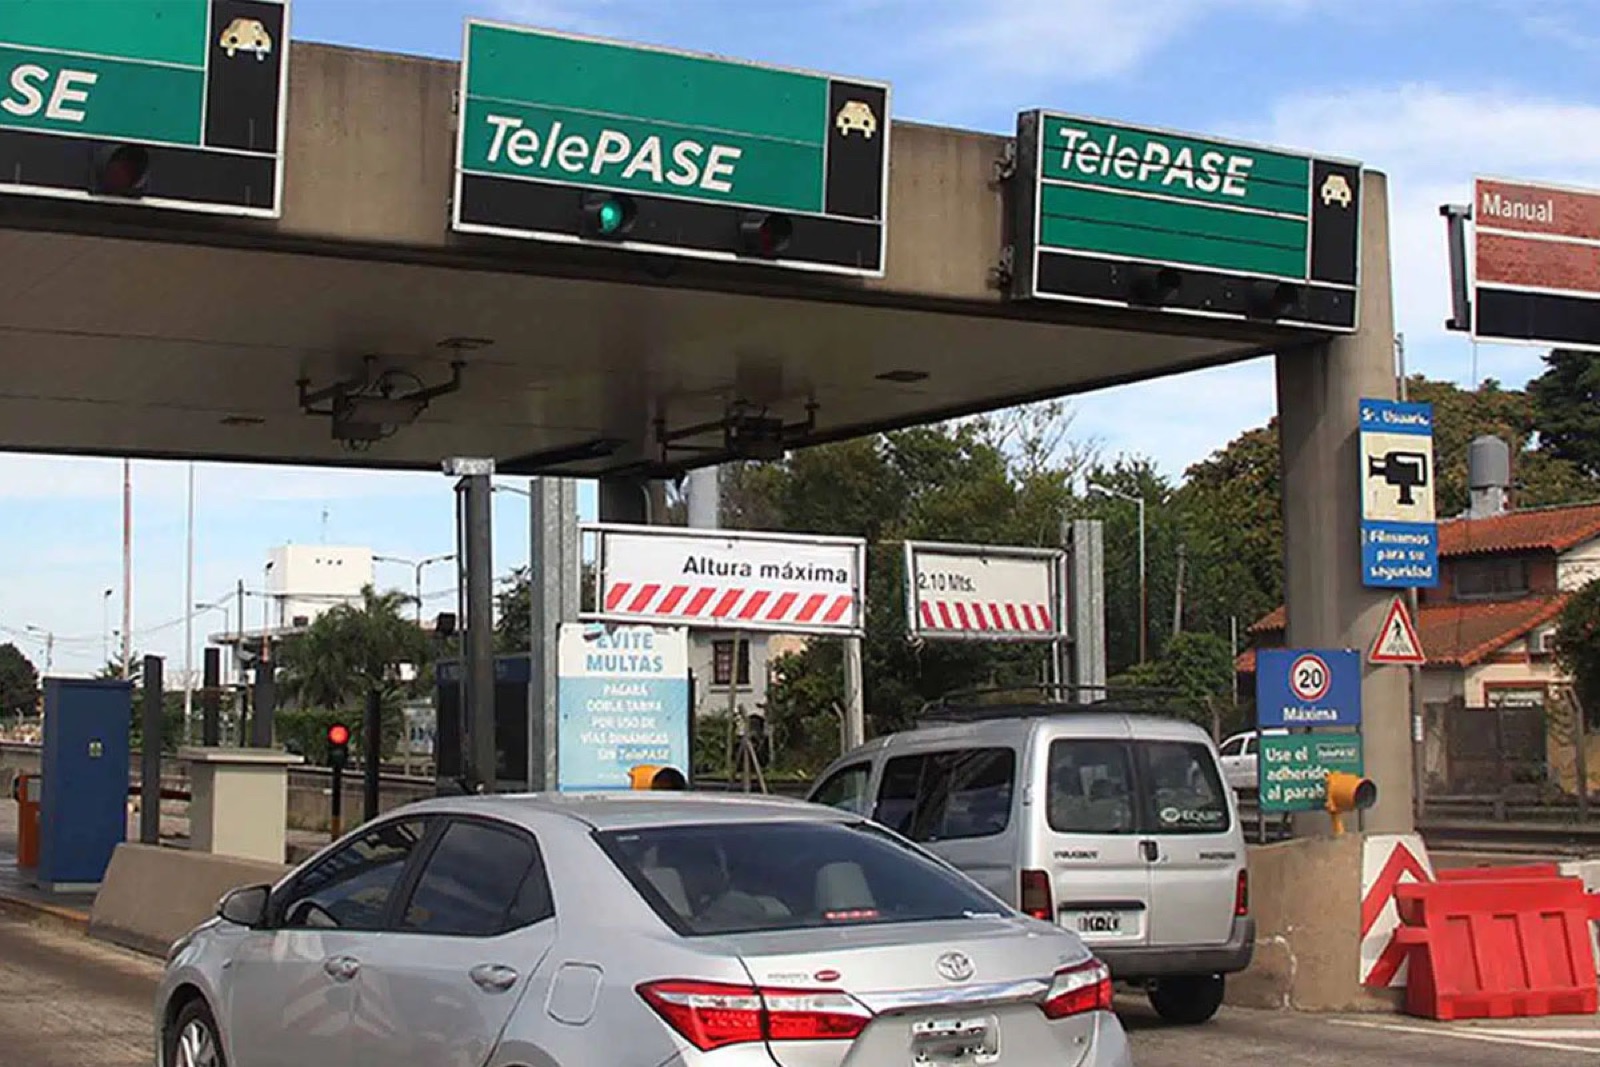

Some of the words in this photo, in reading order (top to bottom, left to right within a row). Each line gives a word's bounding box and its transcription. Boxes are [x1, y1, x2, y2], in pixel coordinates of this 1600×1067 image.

[486, 114, 743, 193] TelePASE
[1059, 127, 1254, 197] TelePASE
[1482, 192, 1554, 224] Manual
[1376, 549, 1406, 562] para
[1409, 549, 1426, 561] su
[682, 555, 752, 578] Altura
[759, 560, 849, 585] máxima
[1370, 563, 1433, 581] seguridad
[596, 630, 654, 649] EVITE
[586, 654, 664, 673] MULTAS
[1299, 668, 1323, 689] 20
[1283, 705, 1338, 721] Máxima
[1265, 747, 1291, 762] Use
[1295, 746, 1309, 761] el
[1267, 784, 1281, 800] al
